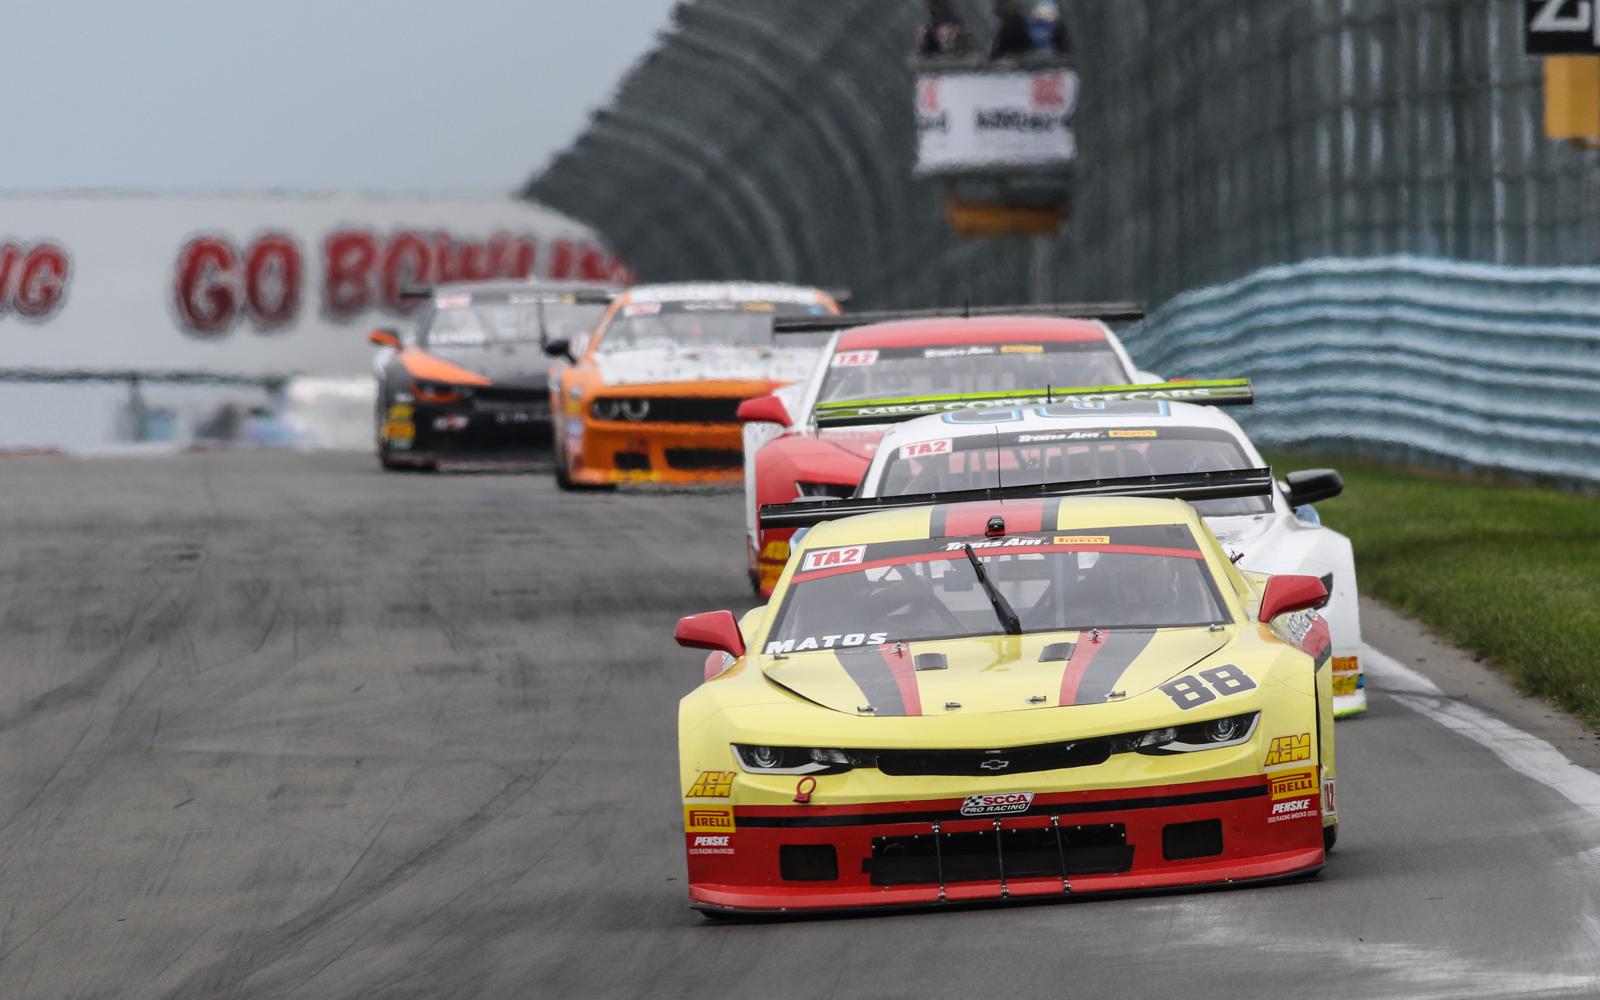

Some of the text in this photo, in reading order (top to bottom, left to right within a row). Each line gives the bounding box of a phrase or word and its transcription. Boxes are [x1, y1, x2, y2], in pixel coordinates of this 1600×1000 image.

[174, 233, 303, 335] GO
[858, 403, 936, 416] MIKE
[1125, 388, 1211, 400] CARS
[907, 441, 946, 456] TA2
[945, 537, 1042, 551] Trans Am
[811, 550, 860, 568] TA2
[765, 632, 888, 655] MATOS
[1158, 663, 1259, 711] 88
[1264, 733, 1311, 767] AEM
[685, 771, 737, 798] AEM
[1271, 772, 1313, 794] PIRELLI
[983, 794, 1028, 806] SCCA
[986, 803, 1026, 812] RACING
[1272, 799, 1311, 815] PENSKE
[689, 810, 731, 828] PIRELLI
[694, 836, 730, 847] PENSKE
